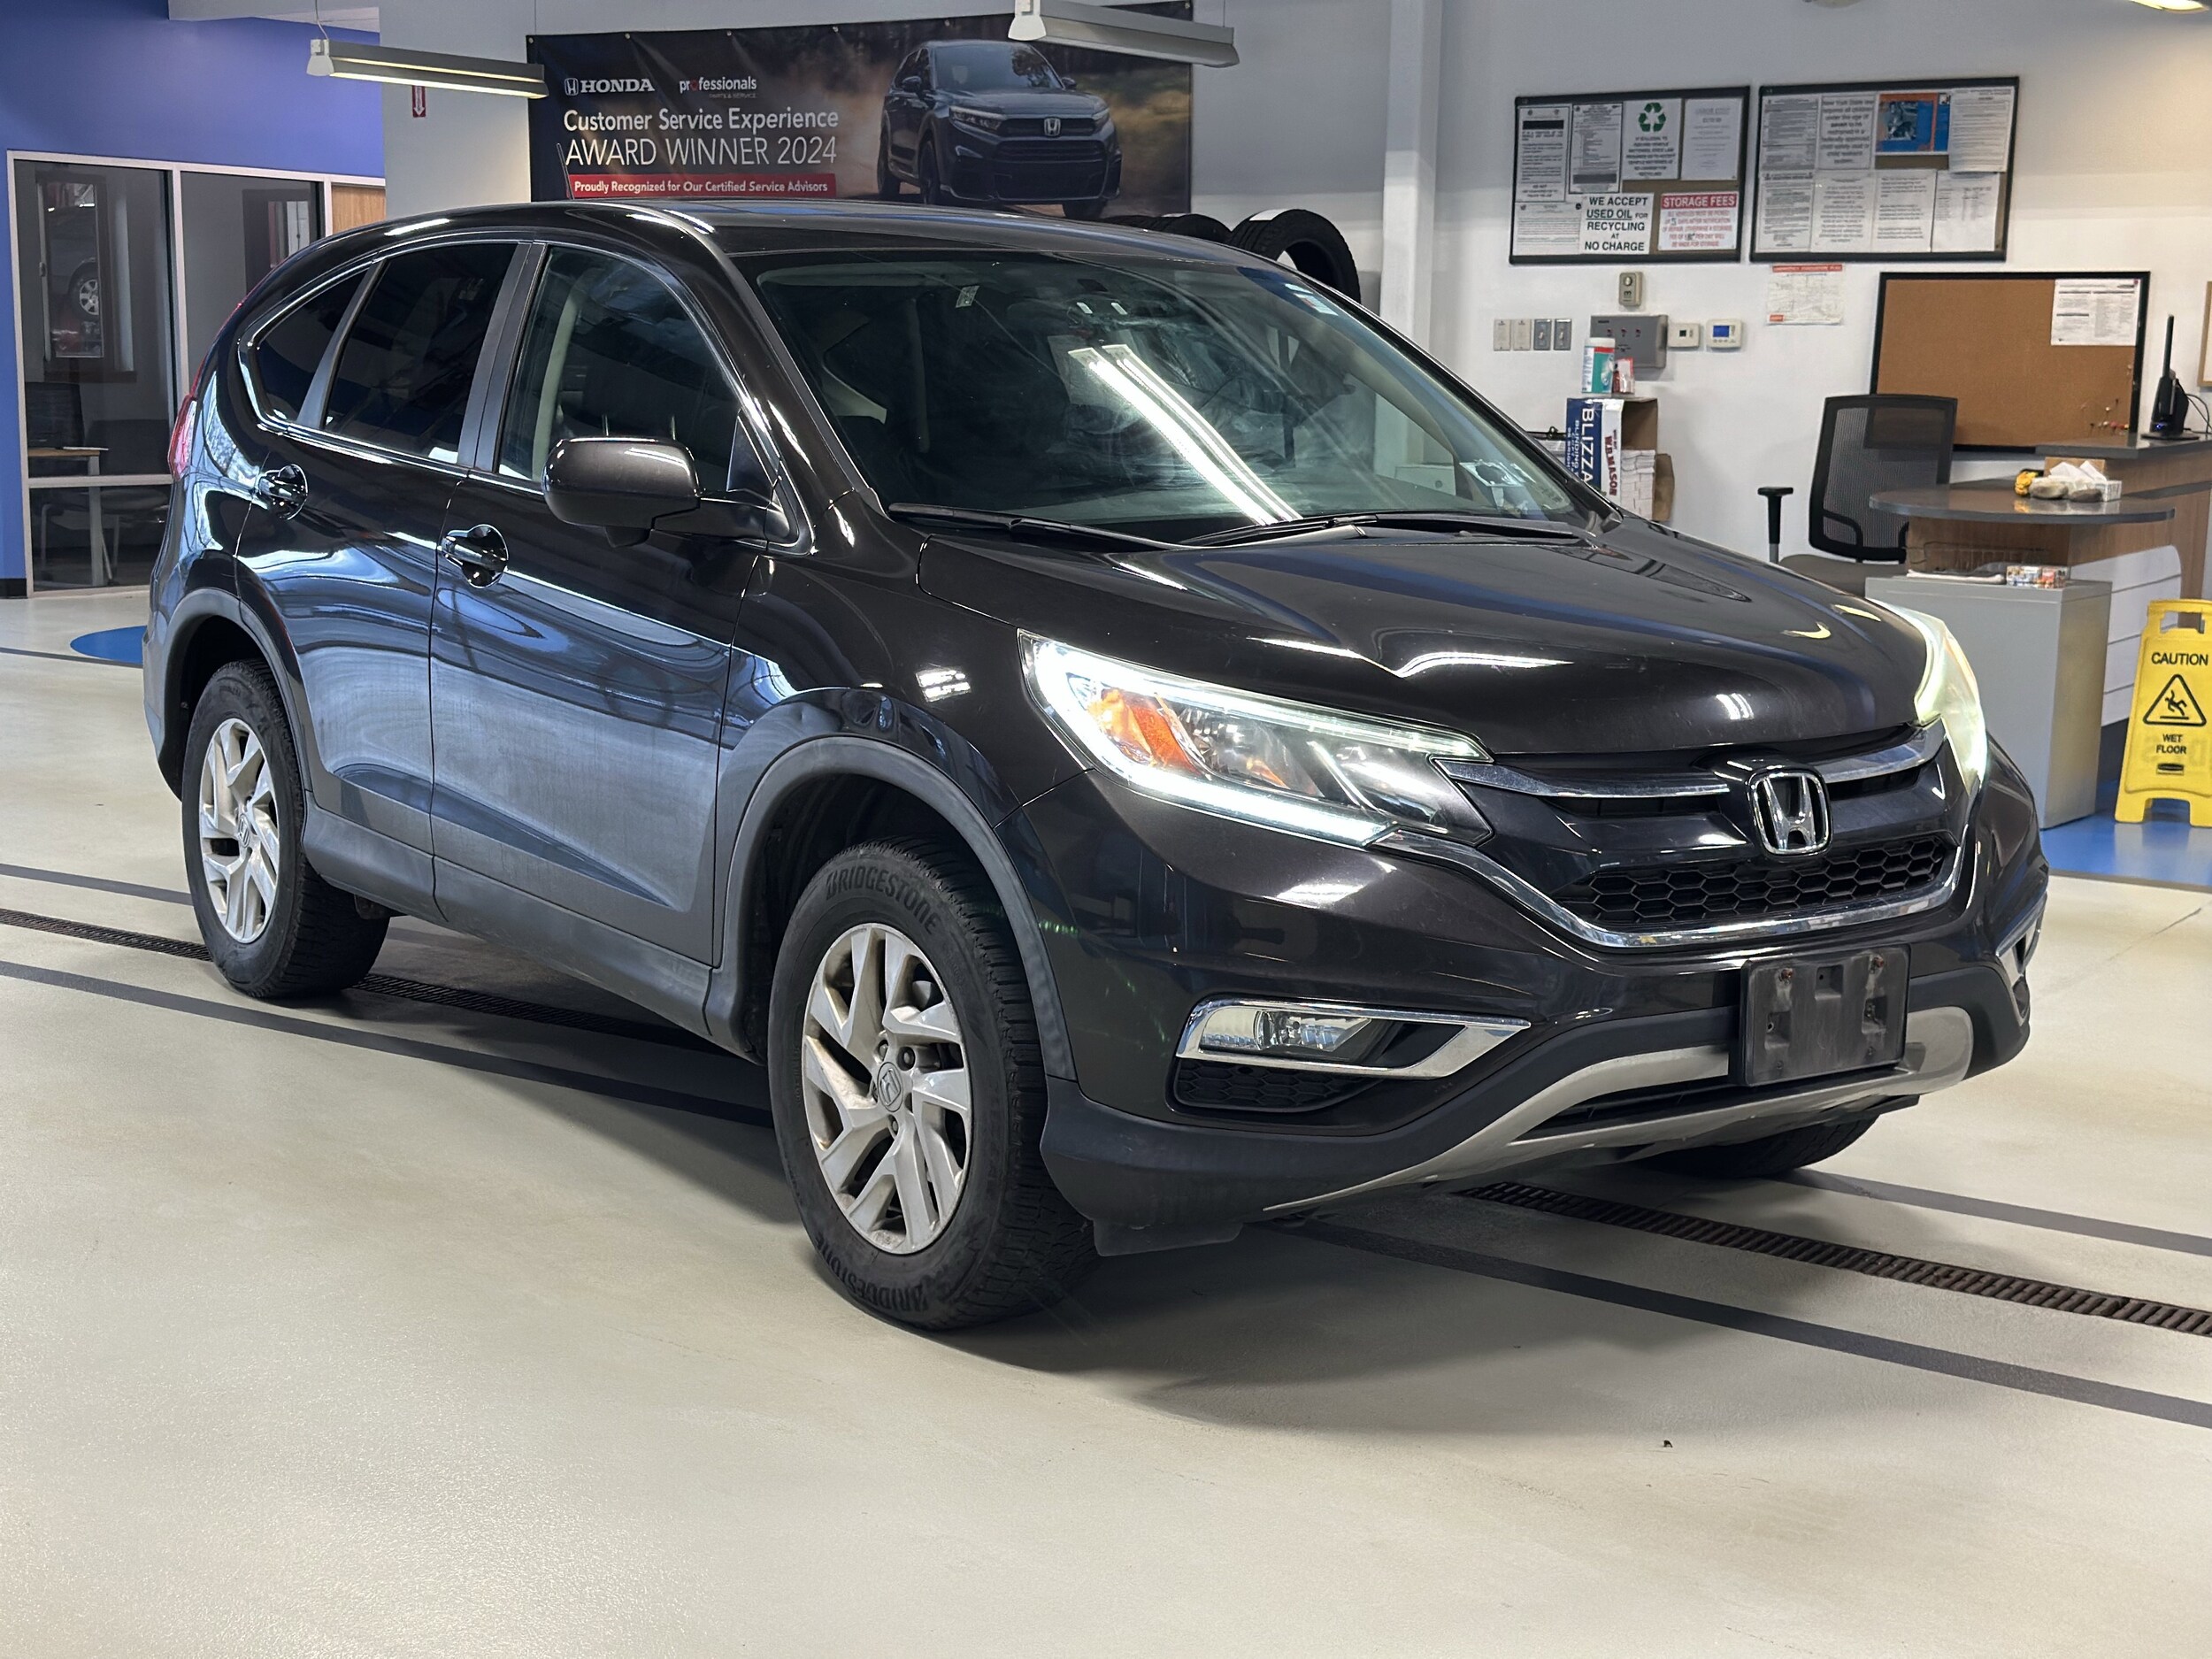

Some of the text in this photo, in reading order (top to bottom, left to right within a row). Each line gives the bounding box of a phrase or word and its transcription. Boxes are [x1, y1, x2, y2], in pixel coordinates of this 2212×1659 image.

[580, 79, 655, 93] HONDA
[679, 76, 757, 94] professionals
[564, 106, 839, 134] Customer Service Experience
[565, 135, 837, 165] AWARD WINNER 2024
[574, 180, 828, 194] Proudly Recognized for Our Certified Service Advisors
[1589, 196, 1647, 205] WE ACCEPT
[1663, 196, 1735, 208] STORAGE FEES
[1586, 209, 1614, 219] USED
[1616, 209, 1632, 219] OIL
[1587, 221, 1645, 231] RECYCLING
[1585, 241, 1645, 251] NO CHARGE
[2151, 652, 2209, 666] CAUTION
[2162, 733, 2183, 743] WET
[2156, 744, 2187, 755] FLOOR
[826, 865, 941, 935] BRIDGESTONE
